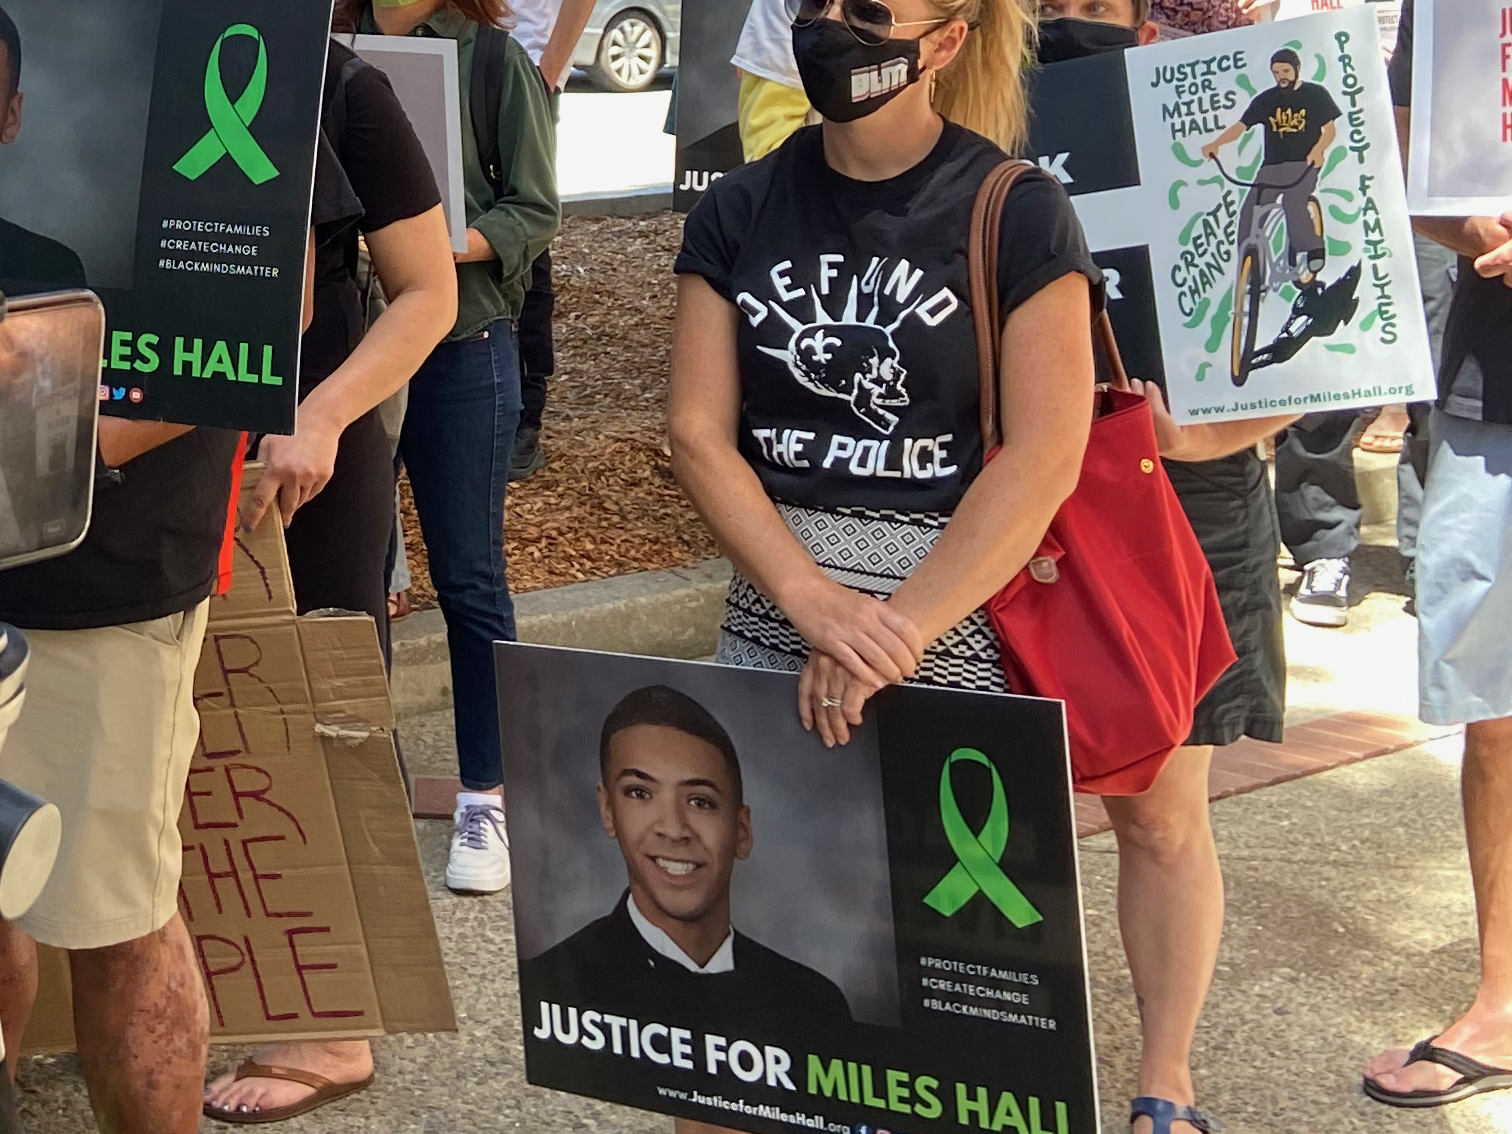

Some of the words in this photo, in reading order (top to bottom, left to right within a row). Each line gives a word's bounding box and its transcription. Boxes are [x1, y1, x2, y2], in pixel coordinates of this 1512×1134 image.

[1150, 50, 1248, 89] JUSTICE
[1174, 77, 1217, 97] FOR
[1161, 91, 1237, 122] MILES
[1170, 113, 1227, 141] HALL
[1334, 31, 1370, 165] PROTECT
[1357, 175, 1399, 345] FAMILIES
[161, 219, 270, 237] #PROTECTFAMILIES
[1171, 189, 1238, 288] CREATE
[160, 239, 258, 256] #CREATECHANGE
[158, 258, 279, 278] #BLACKMINDSMATTER
[1177, 219, 1236, 318] CHANGE
[736, 254, 959, 328] DEFUND
[173, 336, 283, 386] HALL
[1188, 383, 1415, 417] www.JusticeforMilesHall.org
[752, 428, 816, 468] THE
[822, 434, 958, 479] POLICE
[196, 926, 365, 1028] PLE
[920, 956, 1040, 986] #PROTECTFAMILIES
[921, 977, 1031, 1005] #CREATECHANGE
[923, 998, 1057, 1031] #BLACKMINDSMATTER
[533, 1001, 694, 1070] JUSTICE
[704, 1033, 797, 1092] FOR
[806, 1054, 943, 1119] MILES
[656, 1085, 851, 1134] www.JusticeforMilesHall.org
